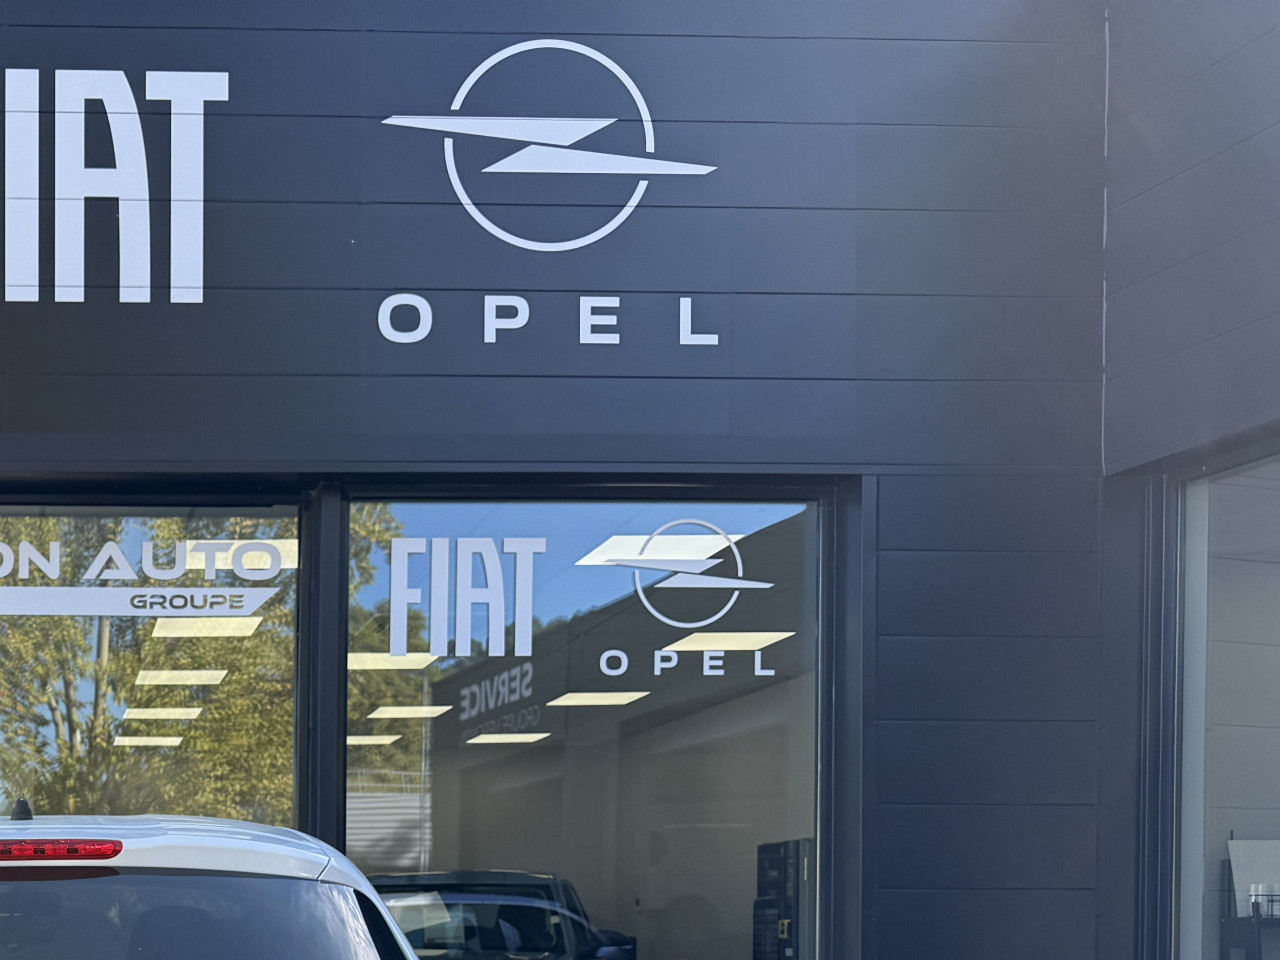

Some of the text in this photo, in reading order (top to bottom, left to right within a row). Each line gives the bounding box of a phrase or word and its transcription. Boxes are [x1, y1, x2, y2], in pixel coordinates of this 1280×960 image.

[377, 293, 719, 345] OPEL
[83, 541, 282, 580] AUTO
[129, 594, 245, 611] GROUPE
[389, 537, 547, 657] FIAT
[599, 649, 776, 676] OPEL
